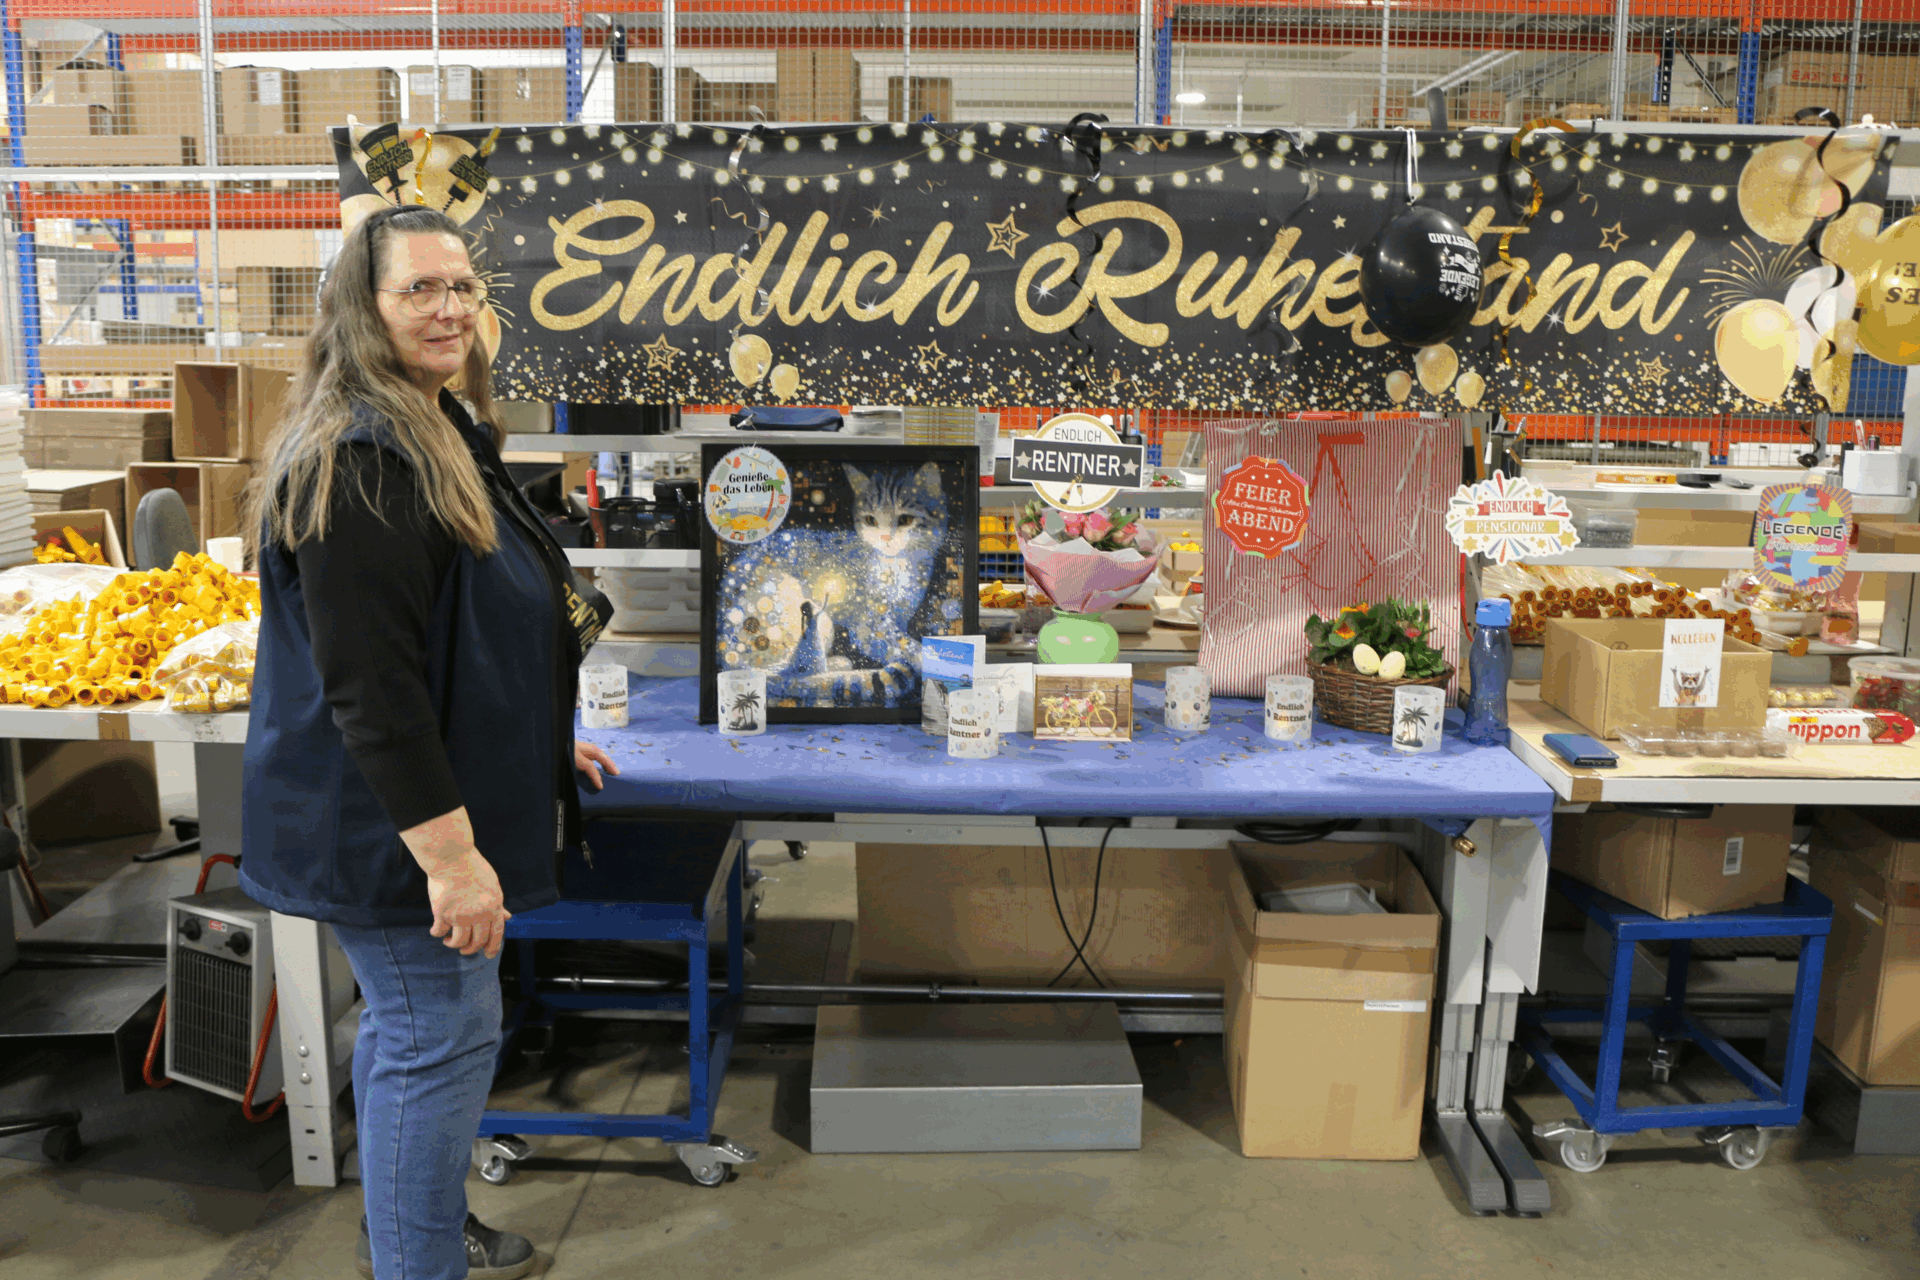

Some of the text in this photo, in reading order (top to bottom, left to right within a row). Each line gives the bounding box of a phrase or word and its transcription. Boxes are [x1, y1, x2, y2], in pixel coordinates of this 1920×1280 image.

[530, 199, 980, 331] Endlich
[1439, 268, 1480, 291] LEGENDE
[1054, 427, 1102, 443] ENDLICH
[1032, 449, 1121, 477] RENTNER
[728, 471, 769, 484] Genieße
[723, 483, 774, 495] das Leben
[1234, 481, 1292, 507] FEIER
[1489, 500, 1534, 513] ENDLICH
[1226, 508, 1294, 534] ABEND
[1762, 519, 1844, 541] LEGENDE
[1276, 702, 1305, 711] Endlich
[1273, 712, 1308, 722] Rentner
[1788, 724, 1861, 743] nippon
